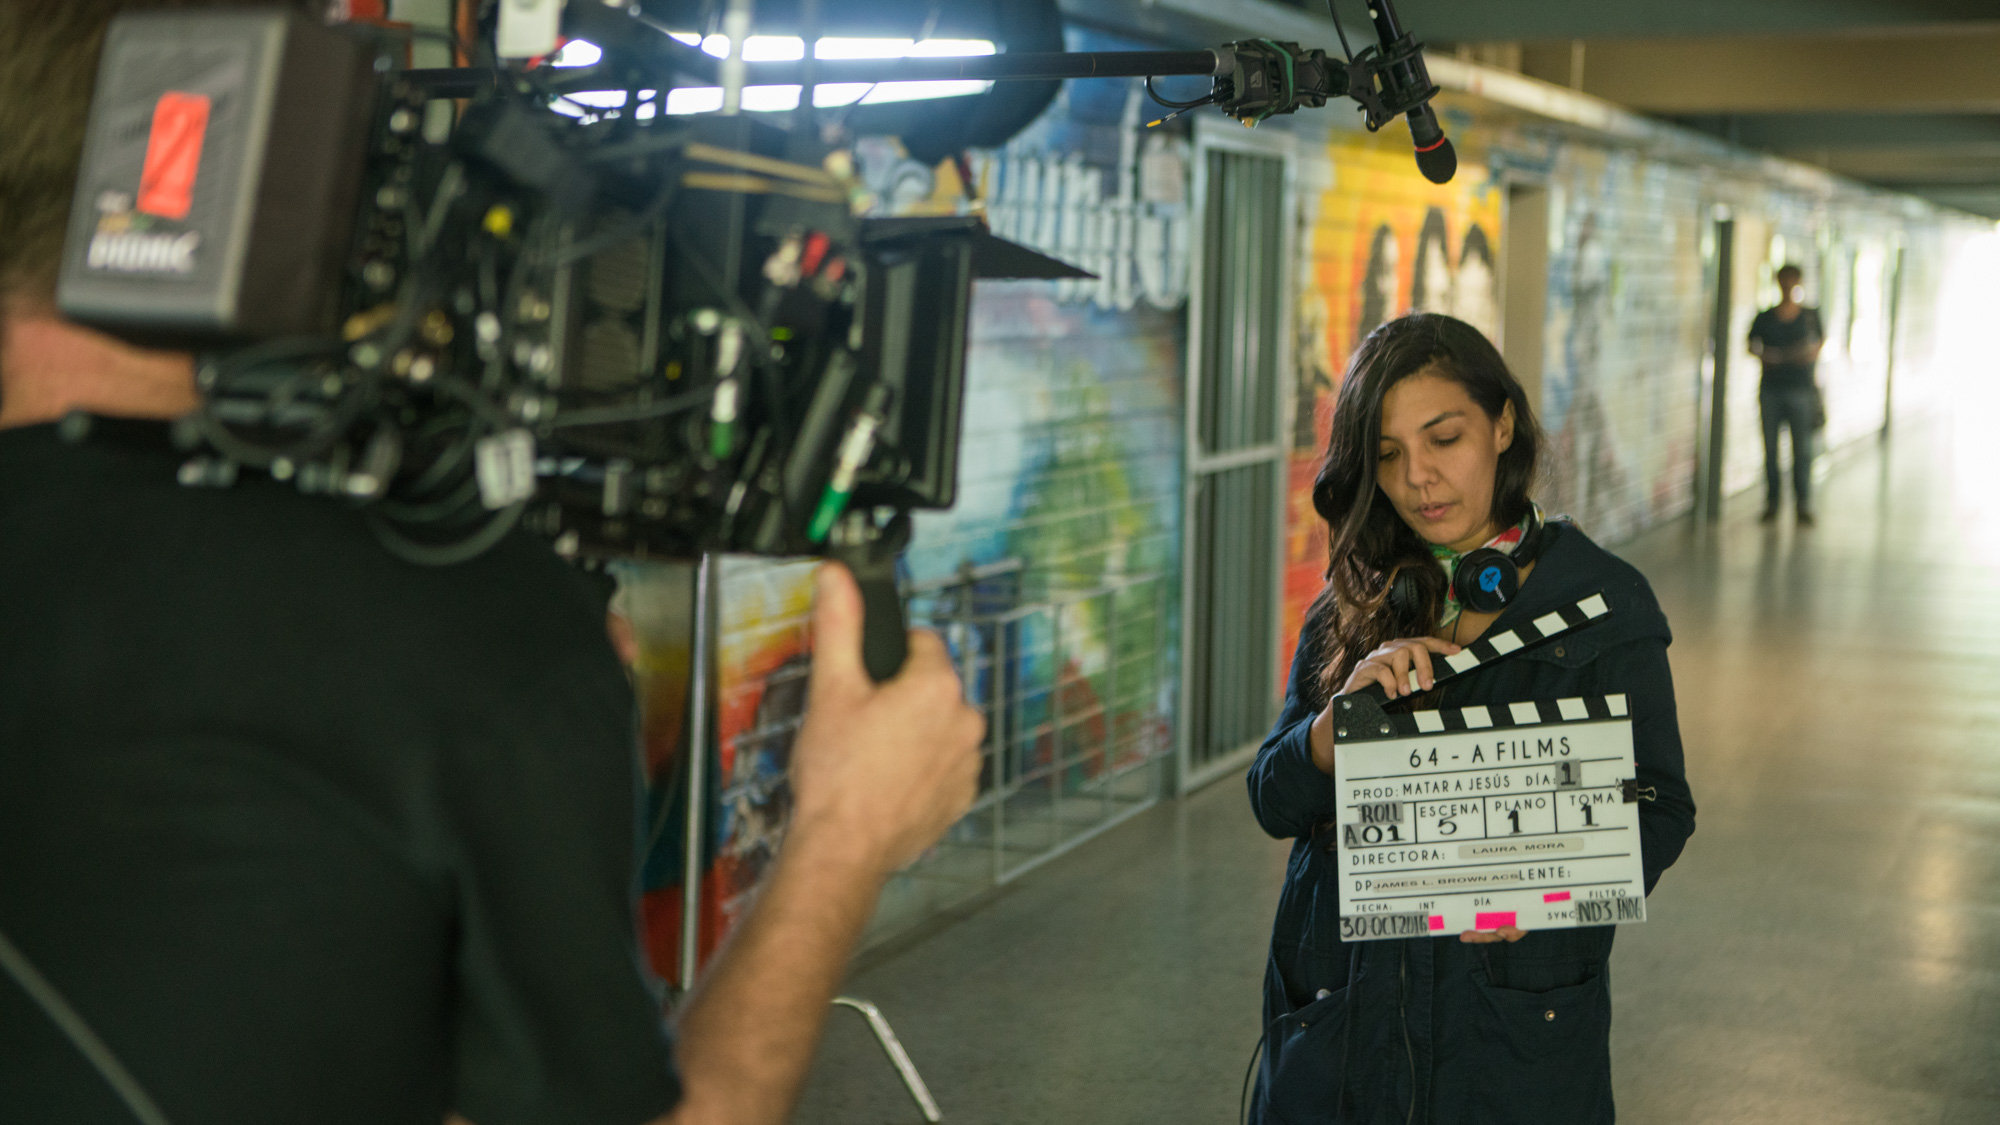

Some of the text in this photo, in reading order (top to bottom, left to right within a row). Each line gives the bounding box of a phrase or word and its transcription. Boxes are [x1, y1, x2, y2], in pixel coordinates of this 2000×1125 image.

[1409, 747, 1438, 768] 64
[1471, 744, 1485, 763] A
[1496, 736, 1571, 762] FILMS
[1353, 761, 1576, 800] PROD: MATAR A JESÚS DÍA: 1
[1495, 797, 1547, 812] PLANO
[1570, 792, 1615, 807] TOMA
[1361, 803, 1401, 825] ROLL
[1420, 803, 1479, 818] ESCENA
[1580, 803, 1600, 827] 1
[1437, 814, 1458, 836] 5
[1507, 809, 1523, 835] 1
[1352, 842, 1565, 866] DIRECTORA: LAURA MORA
[1373, 881, 1419, 890] JAMES
[1438, 875, 1487, 885] BROWN
[1491, 873, 1519, 882] ACS
[1518, 865, 1572, 881] LENTE:
[1474, 896, 1492, 907] DÍA
[1589, 888, 1626, 899] FILTRO
[1356, 903, 1393, 913] FECHA:
[1419, 901, 1436, 910] INT
[1547, 911, 1576, 920] SYNC
[1577, 901, 1613, 922] ND3
[1340, 916, 1367, 938] 30
